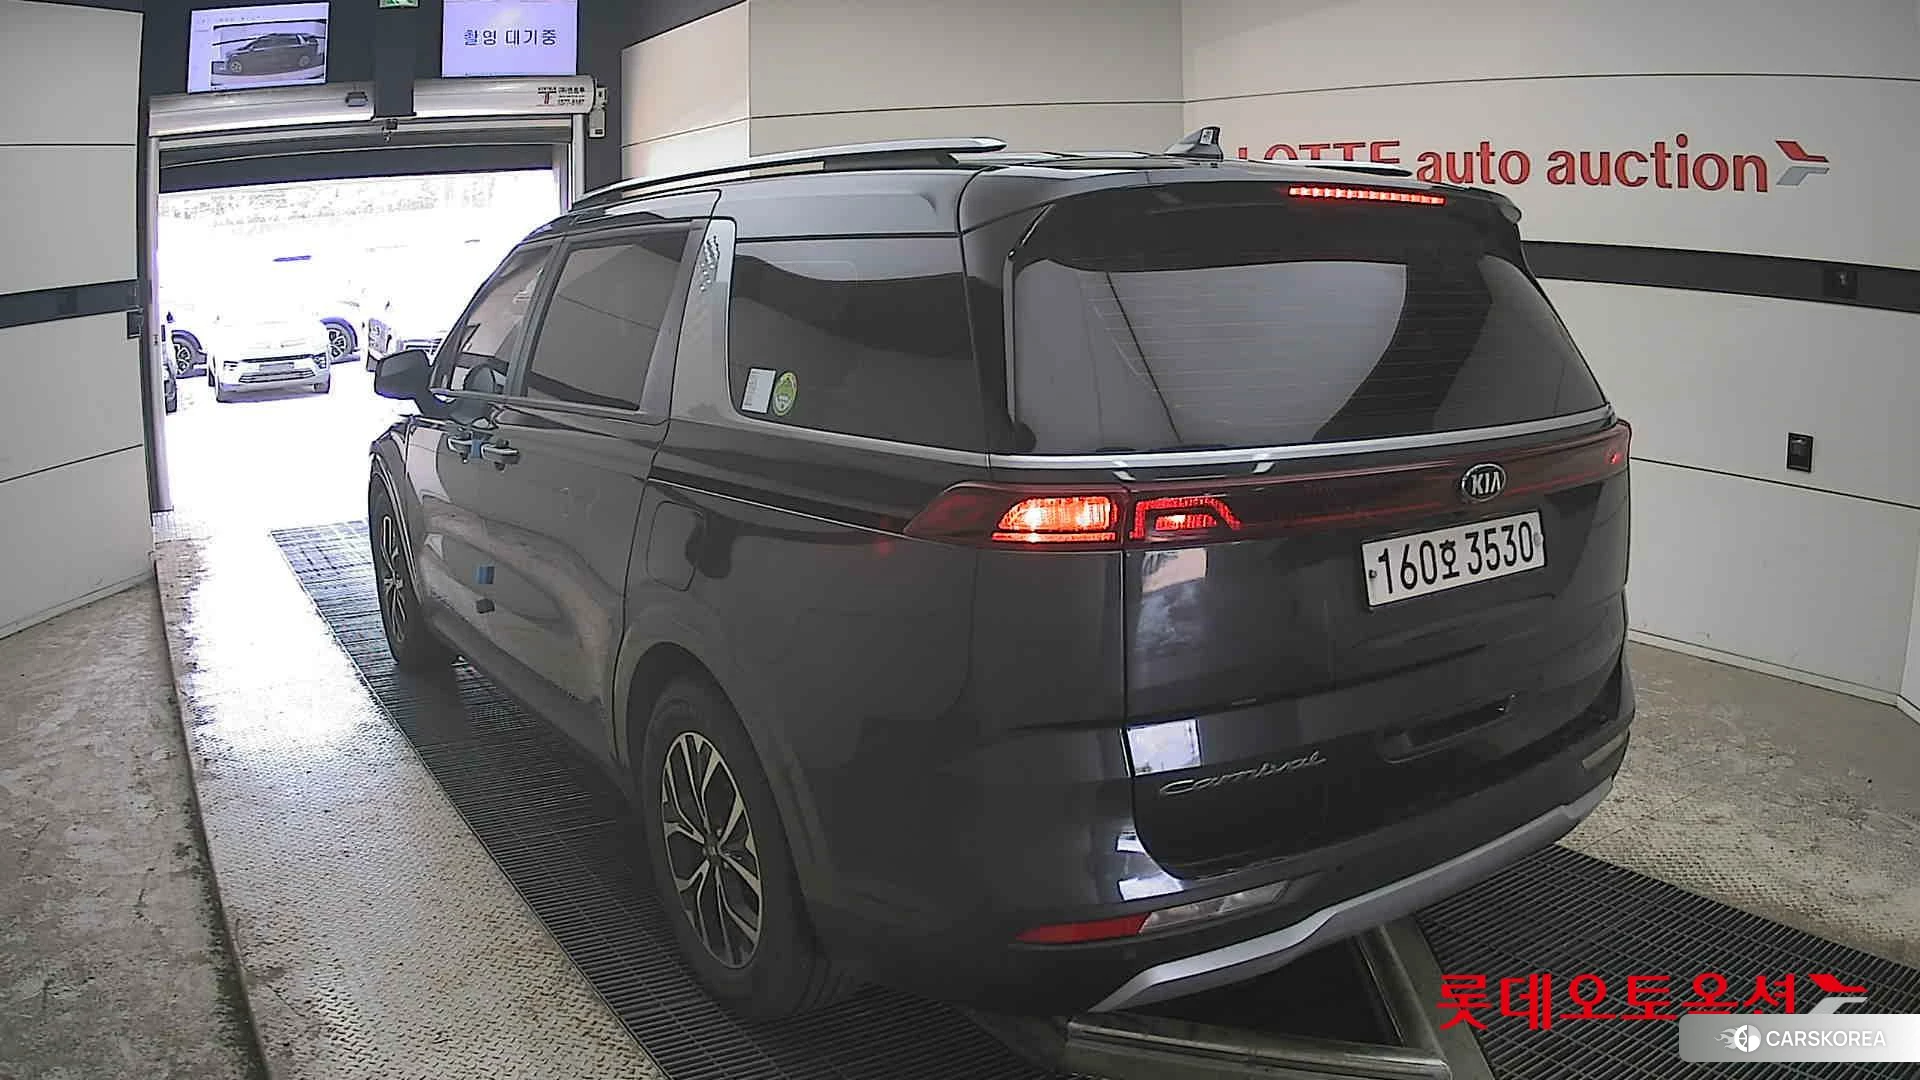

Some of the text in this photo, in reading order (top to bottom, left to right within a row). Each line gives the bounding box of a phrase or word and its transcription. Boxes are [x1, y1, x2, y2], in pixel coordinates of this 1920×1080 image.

[505, 29, 557, 46] 대기중
[1416, 141, 1530, 185] auto
[1547, 133, 1768, 193] auction
[1471, 471, 1501, 496] KIA
[1465, 521, 1534, 575] 3530
[1159, 750, 1327, 795] Carnival
